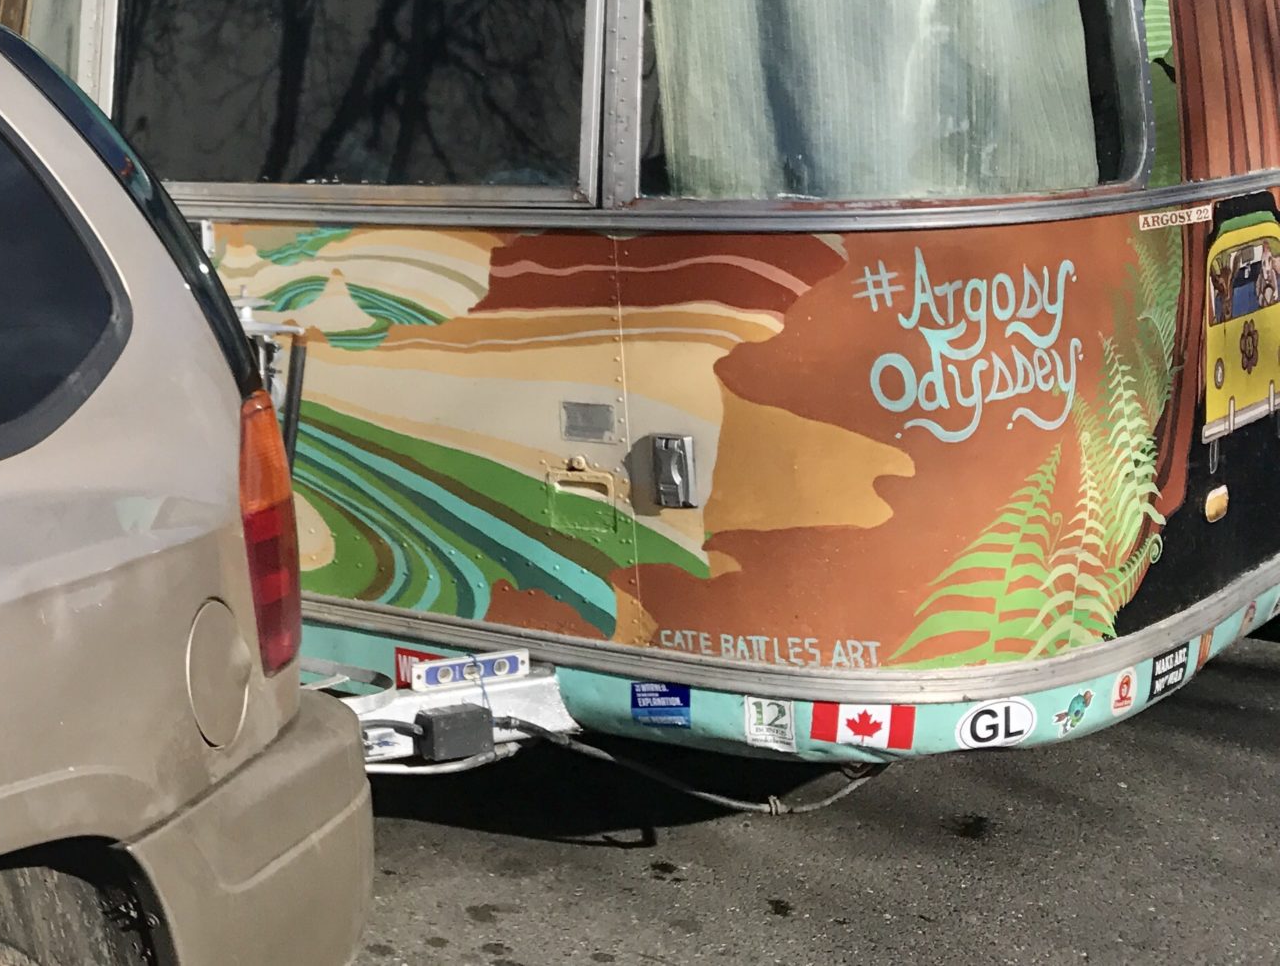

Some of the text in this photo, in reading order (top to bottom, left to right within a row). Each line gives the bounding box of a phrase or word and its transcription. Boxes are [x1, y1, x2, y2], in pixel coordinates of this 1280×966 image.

[1141, 208, 1210, 229] ARGOSY 22
[870, 337, 1083, 443] Odyssey
[661, 630, 881, 669] CATE BATTLES ART
[751, 700, 788, 729] 12
[970, 705, 1024, 743] GL
